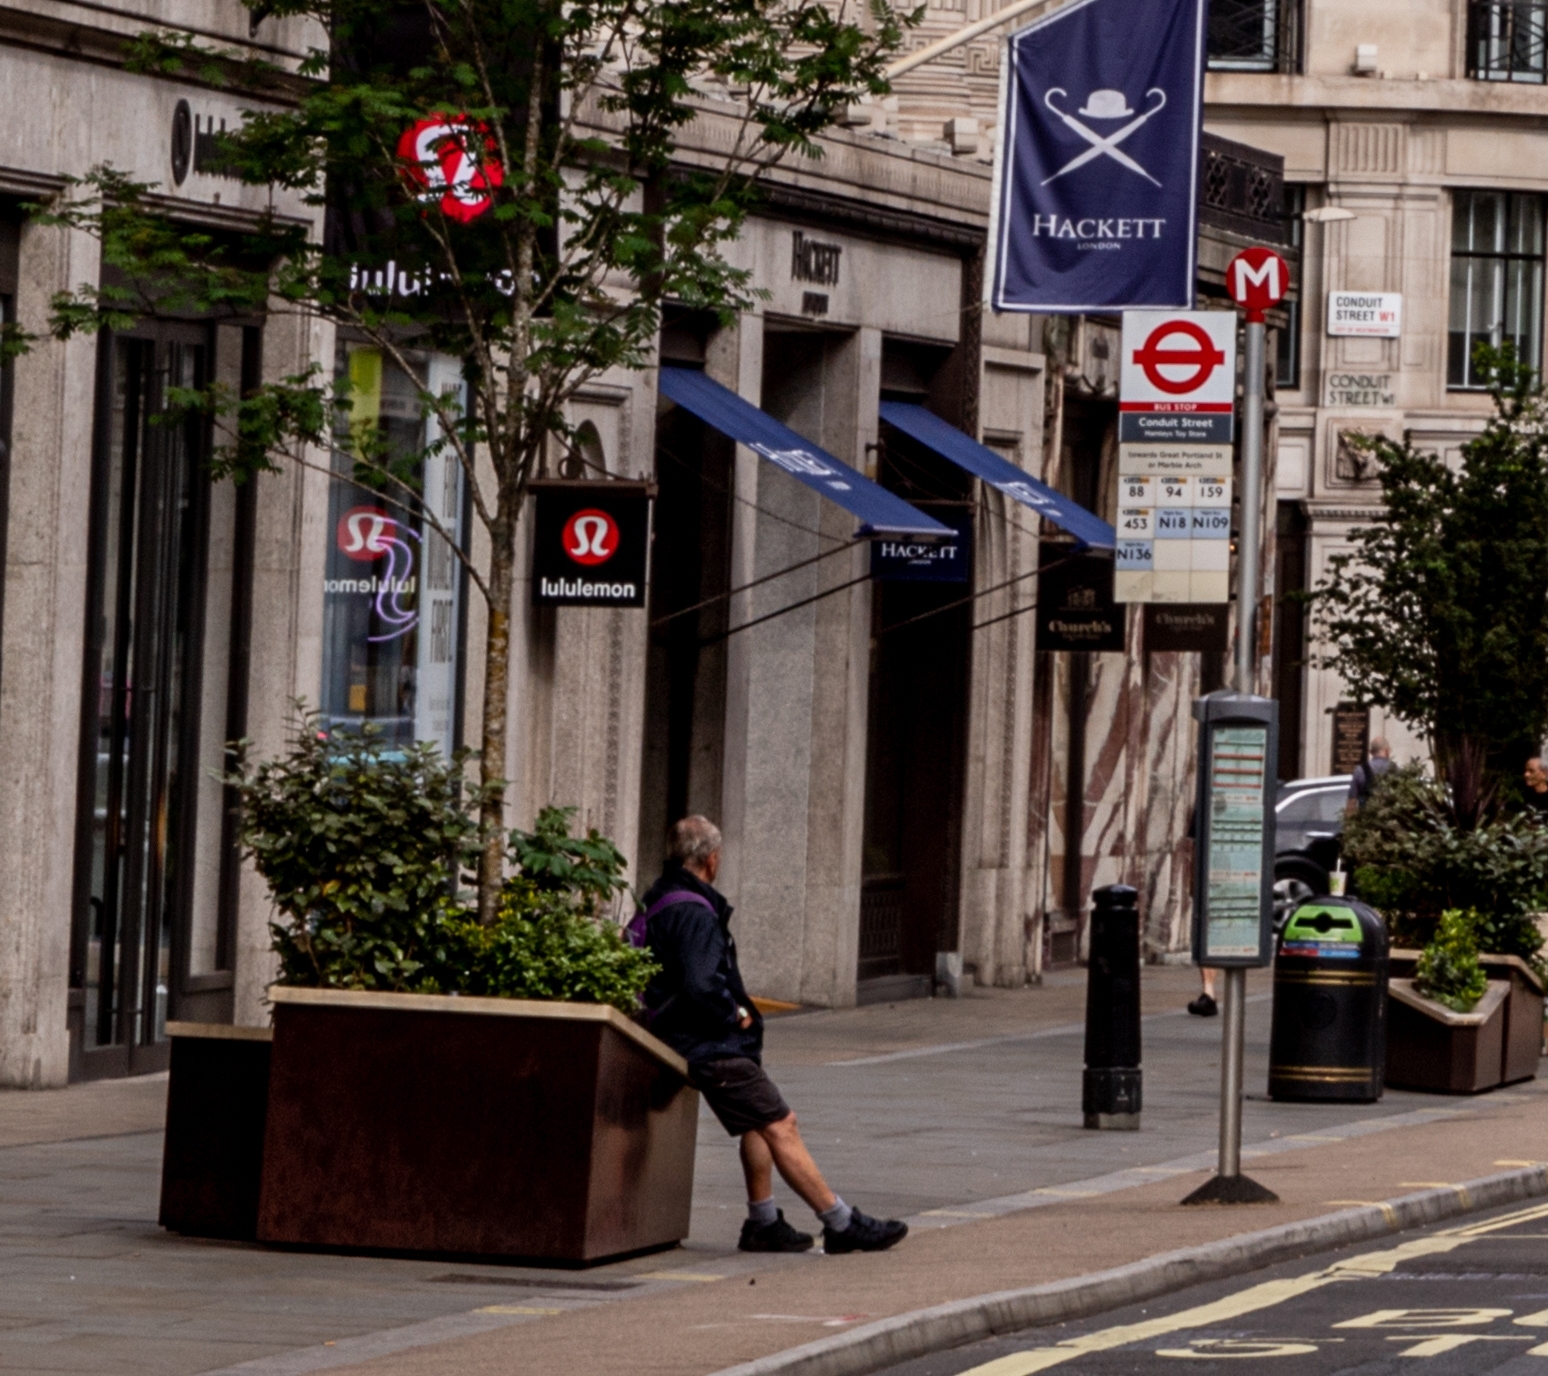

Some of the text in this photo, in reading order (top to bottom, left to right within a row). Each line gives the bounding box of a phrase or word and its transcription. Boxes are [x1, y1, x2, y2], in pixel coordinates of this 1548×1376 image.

[1032, 214, 1167, 239] HACKETT
[1077, 241, 1121, 250] LONDON
[1235, 256, 1280, 302] M
[1336, 297, 1383, 308] CONDUIT
[1336, 310, 1395, 322] STREET W1
[1329, 374, 1392, 389] CONDUIT
[1329, 391, 1380, 405] STREET
[1139, 417, 1213, 428] Conduit Street
[1129, 486, 1145, 497] 88
[1166, 487, 1182, 497] 94
[1201, 487, 1223, 497] 159
[1124, 518, 1148, 529] 453
[1159, 517, 1186, 529] N18
[1193, 517, 1229, 529] N109
[1116, 549, 1152, 560] N136
[541, 576, 635, 598] lululemon
